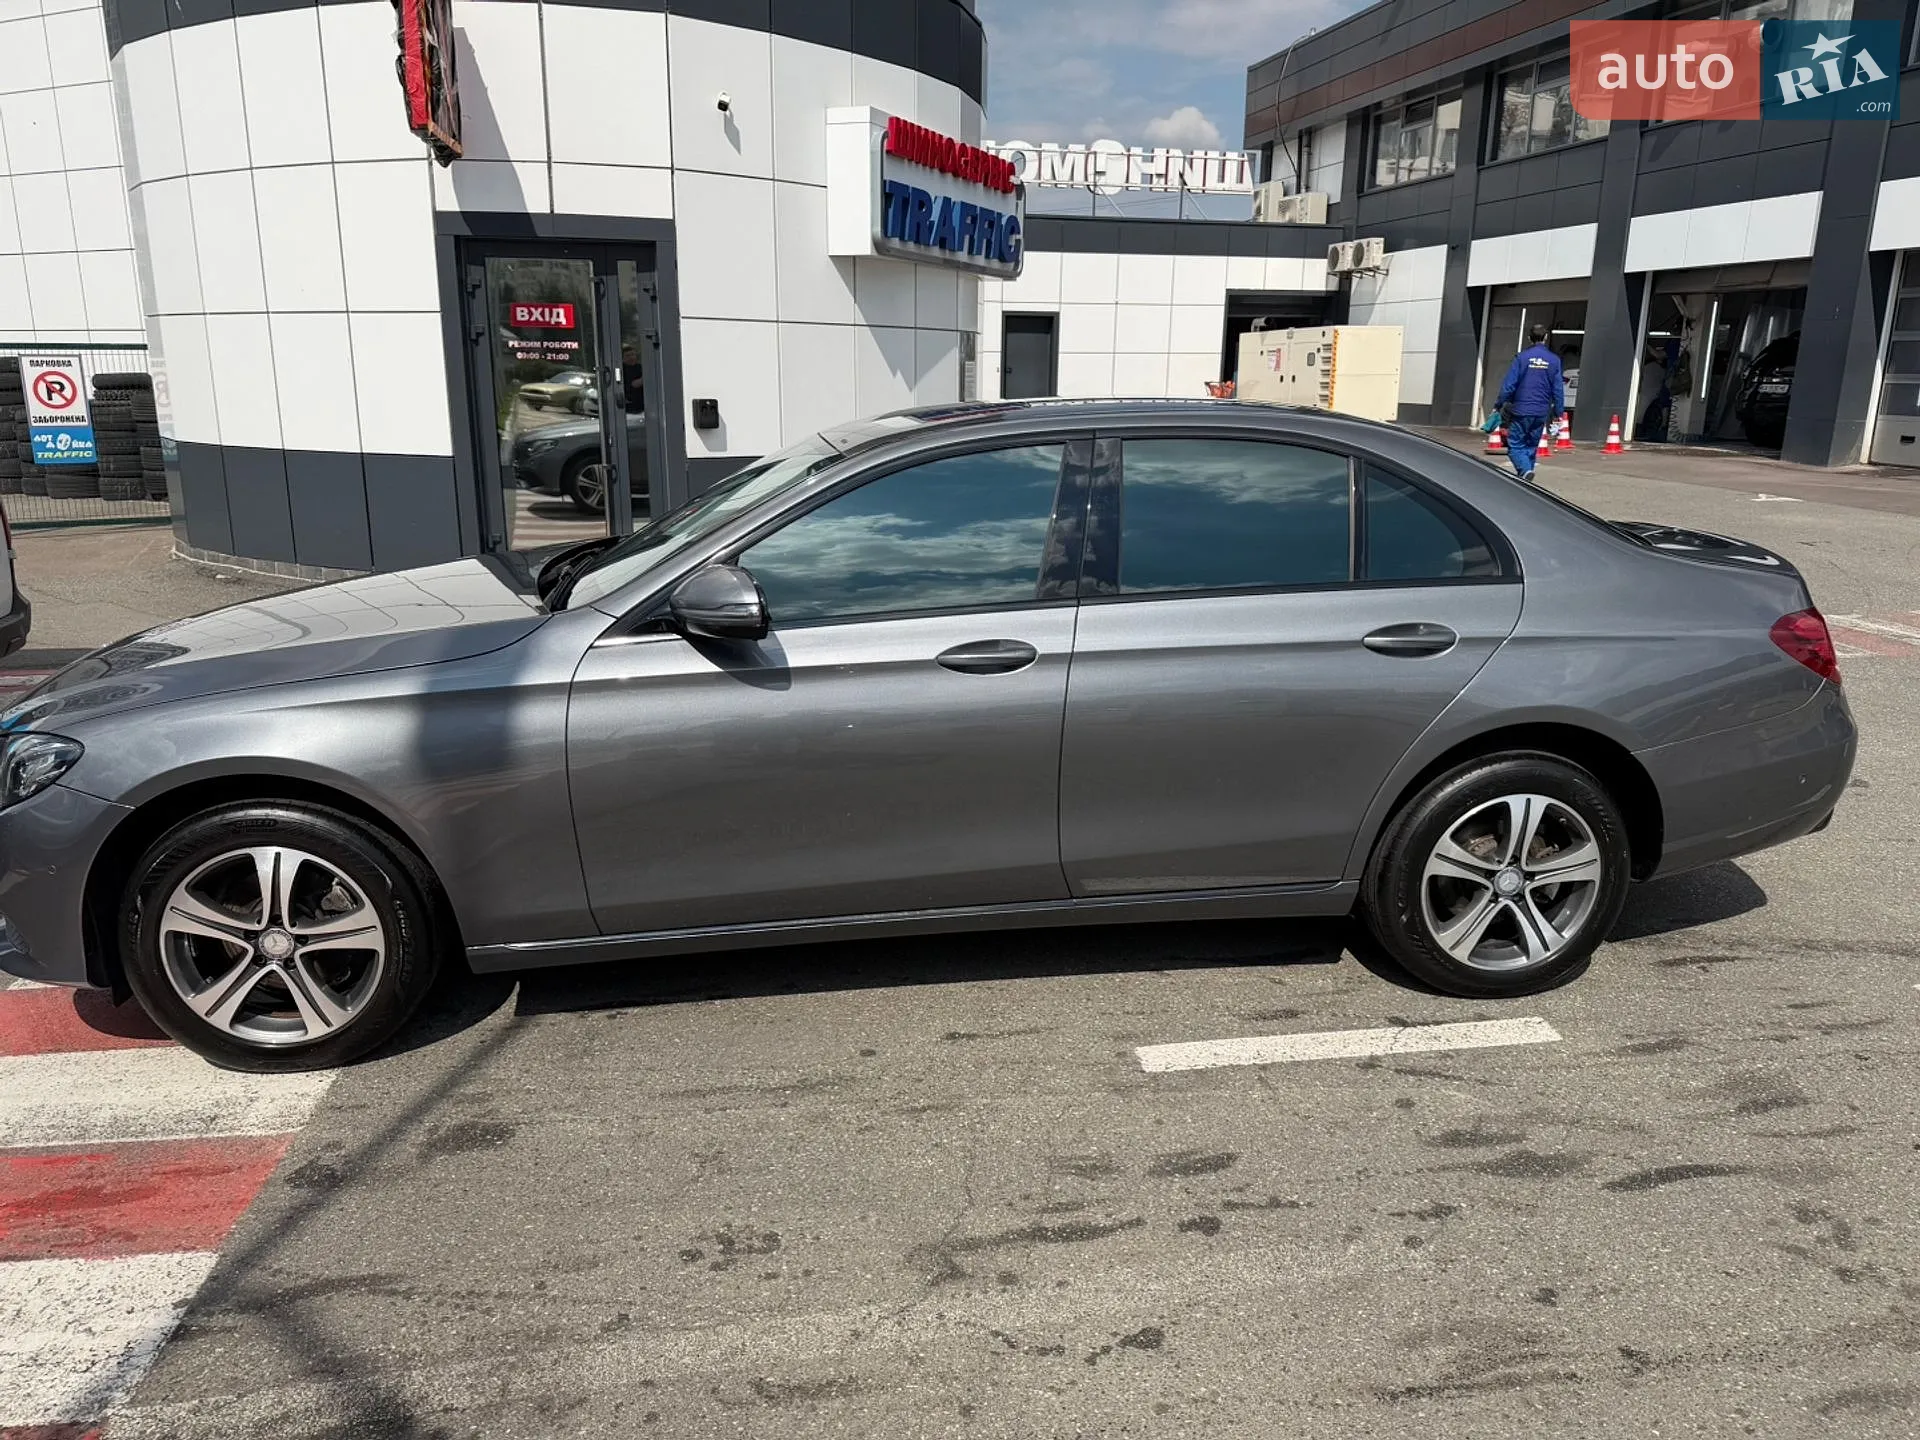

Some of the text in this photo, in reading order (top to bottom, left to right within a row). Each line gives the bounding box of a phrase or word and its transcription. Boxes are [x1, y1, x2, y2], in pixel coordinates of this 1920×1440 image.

[885, 116, 1016, 194] ШИНОСЕРВІС
[883, 179, 1021, 263] TRAFFIC
[515, 306, 567, 325] ВХІД
[508, 340, 579, 349] РЕЖИМ РОБОТИ
[546, 353, 570, 361] 21:00
[29, 359, 73, 368] ПАРКОВКА
[32, 415, 87, 424] ЗАБОРОНЕНА
[36, 450, 93, 459] TRAFFIC
